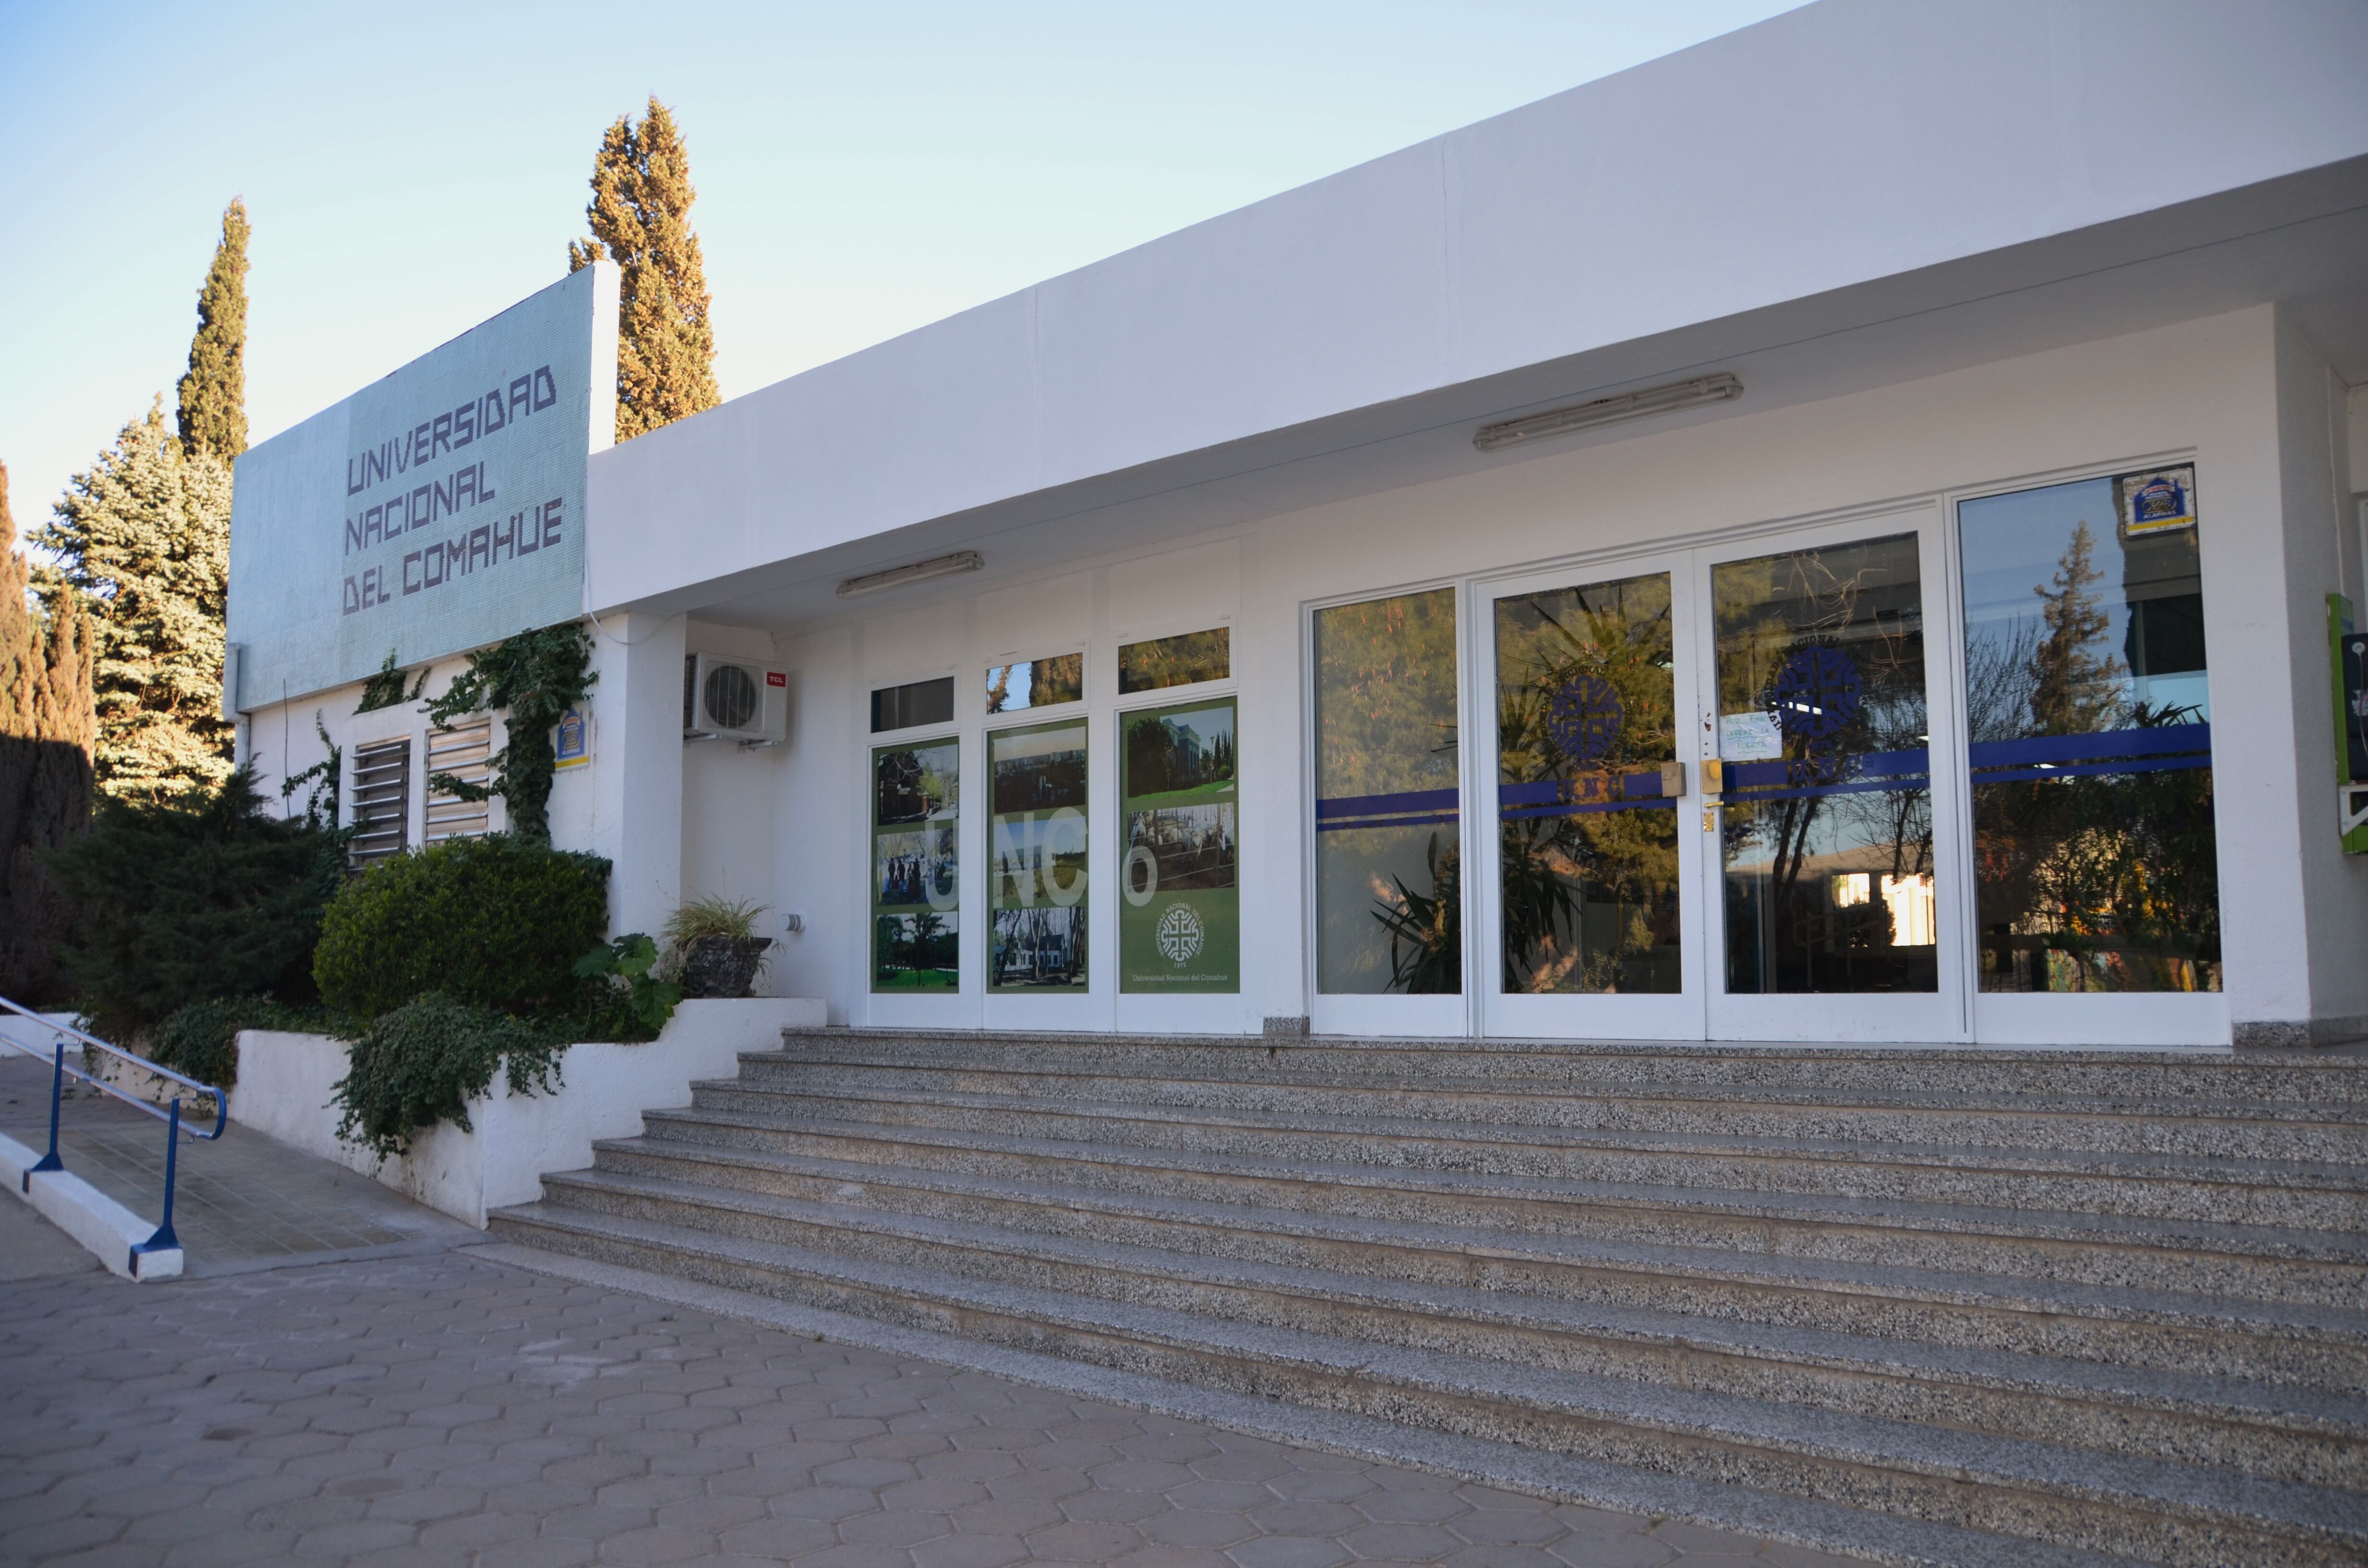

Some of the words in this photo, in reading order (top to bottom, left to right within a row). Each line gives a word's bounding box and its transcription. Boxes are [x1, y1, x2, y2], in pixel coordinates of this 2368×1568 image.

[347, 364, 556, 497] UNIVERSIDAD
[345, 461, 495, 556] NACIONAL
[342, 564, 390, 616] DEL
[403, 497, 562, 596] COMAHUE
[1734, 740, 1767, 749] PUERTA
[1165, 903, 1191, 913] NACIONAL
[1192, 909, 1201, 921] DEL
[1156, 913, 1166, 956] UNIVERSIDAD
[1196, 921, 1205, 956] COMAHUE
